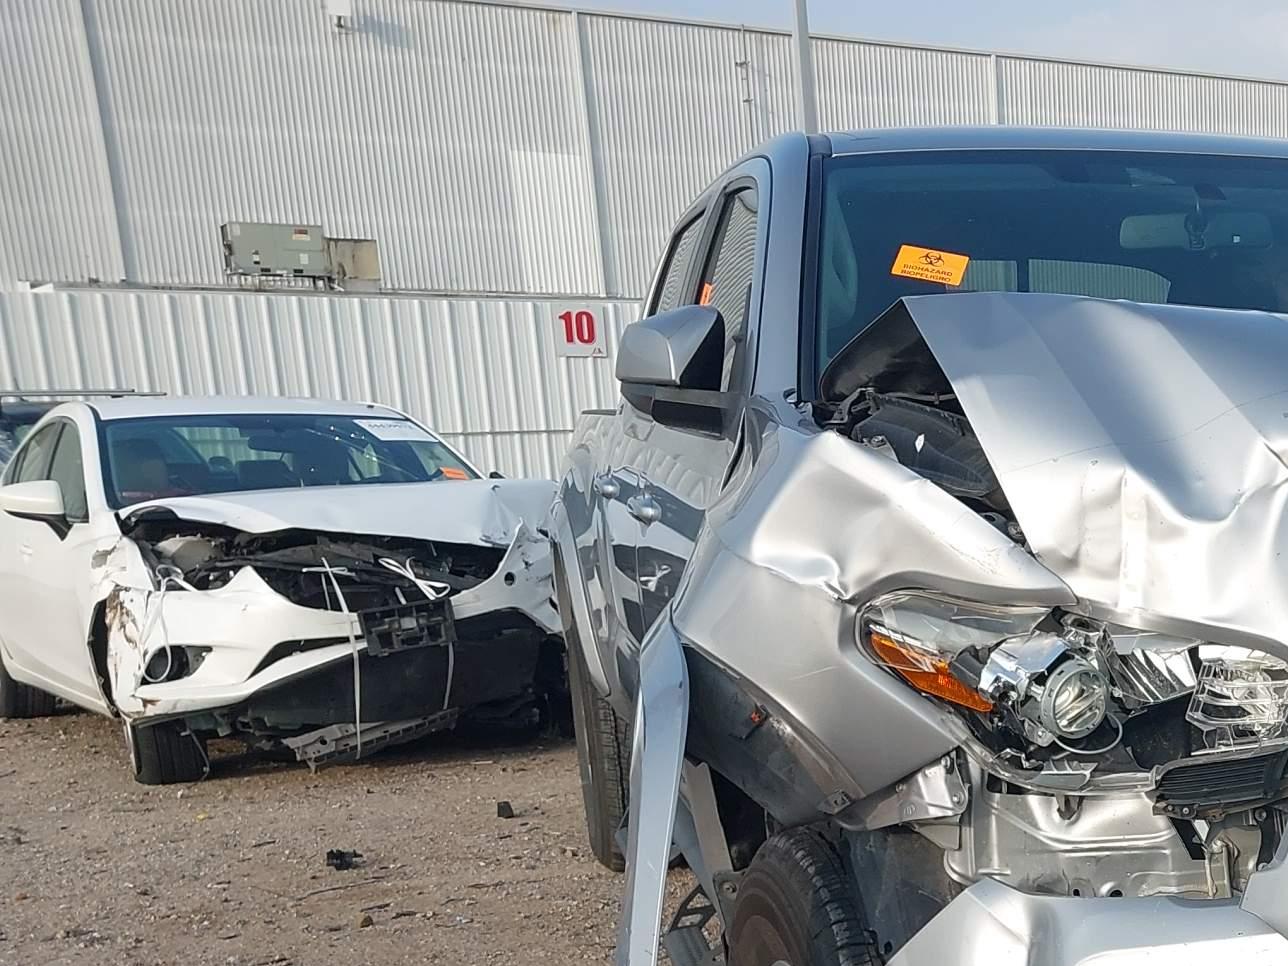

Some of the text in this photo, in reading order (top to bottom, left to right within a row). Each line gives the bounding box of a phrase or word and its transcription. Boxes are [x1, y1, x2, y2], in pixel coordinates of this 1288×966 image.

[900, 269, 952, 283] BIOPELIGRO
[903, 263, 953, 277] BIOHAZARD
[558, 311, 595, 344] 10
